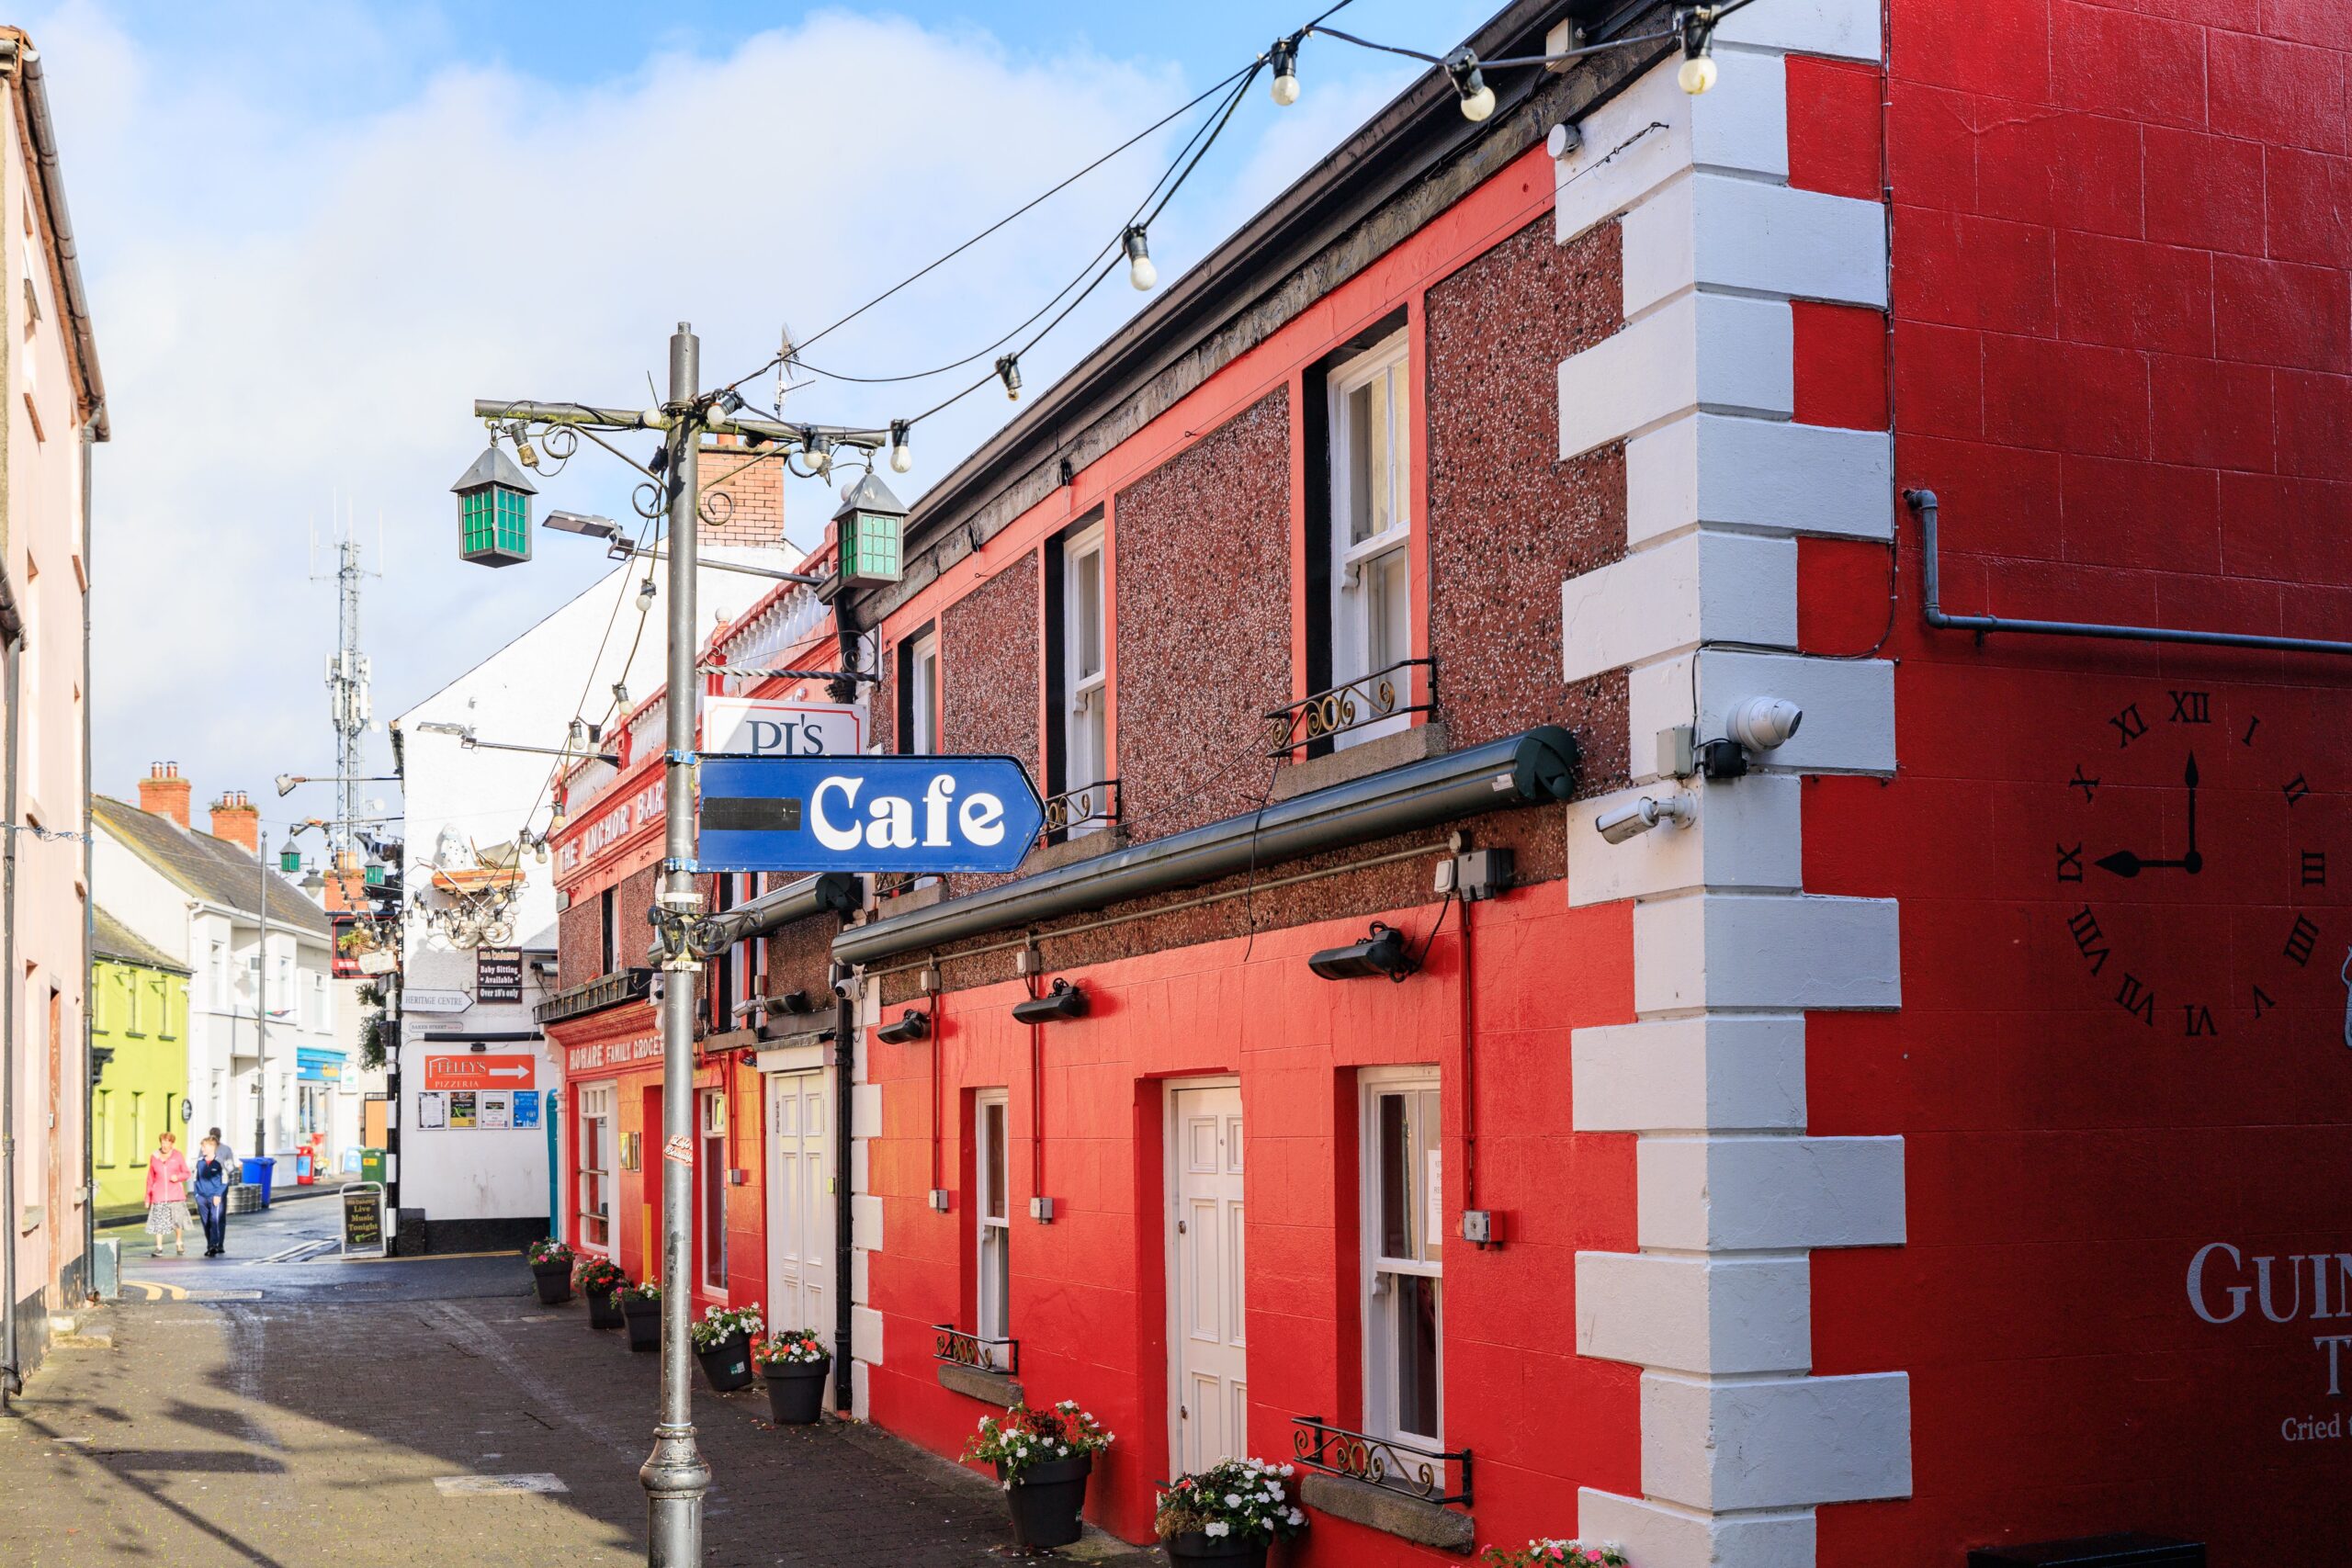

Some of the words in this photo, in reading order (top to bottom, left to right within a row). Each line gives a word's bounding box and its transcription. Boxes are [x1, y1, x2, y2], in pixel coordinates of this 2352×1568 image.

[2168, 691, 2211, 724] XII
[2109, 703, 2149, 748] XI
[809, 773, 1005, 852] Cafe
[559, 837, 580, 874] THE
[583, 805, 631, 859] ANCHOR
[637, 780, 666, 825] BAR
[480, 965, 495, 975] Baby
[496, 965, 518, 975] Sitting
[485, 976, 514, 984] Available
[405, 995, 436, 1005] HERITAGE
[437, 996, 463, 1007] CENTRE
[480, 988, 493, 998] Over
[505, 988, 519, 998] only
[606, 1041, 632, 1064] FAMILY
[428, 1057, 486, 1078] FEELEY'S
[435, 1080, 480, 1089] PIZZERIA
[348, 1223, 379, 1232] Tonight
[2281, 1412, 2342, 1442] Cried
